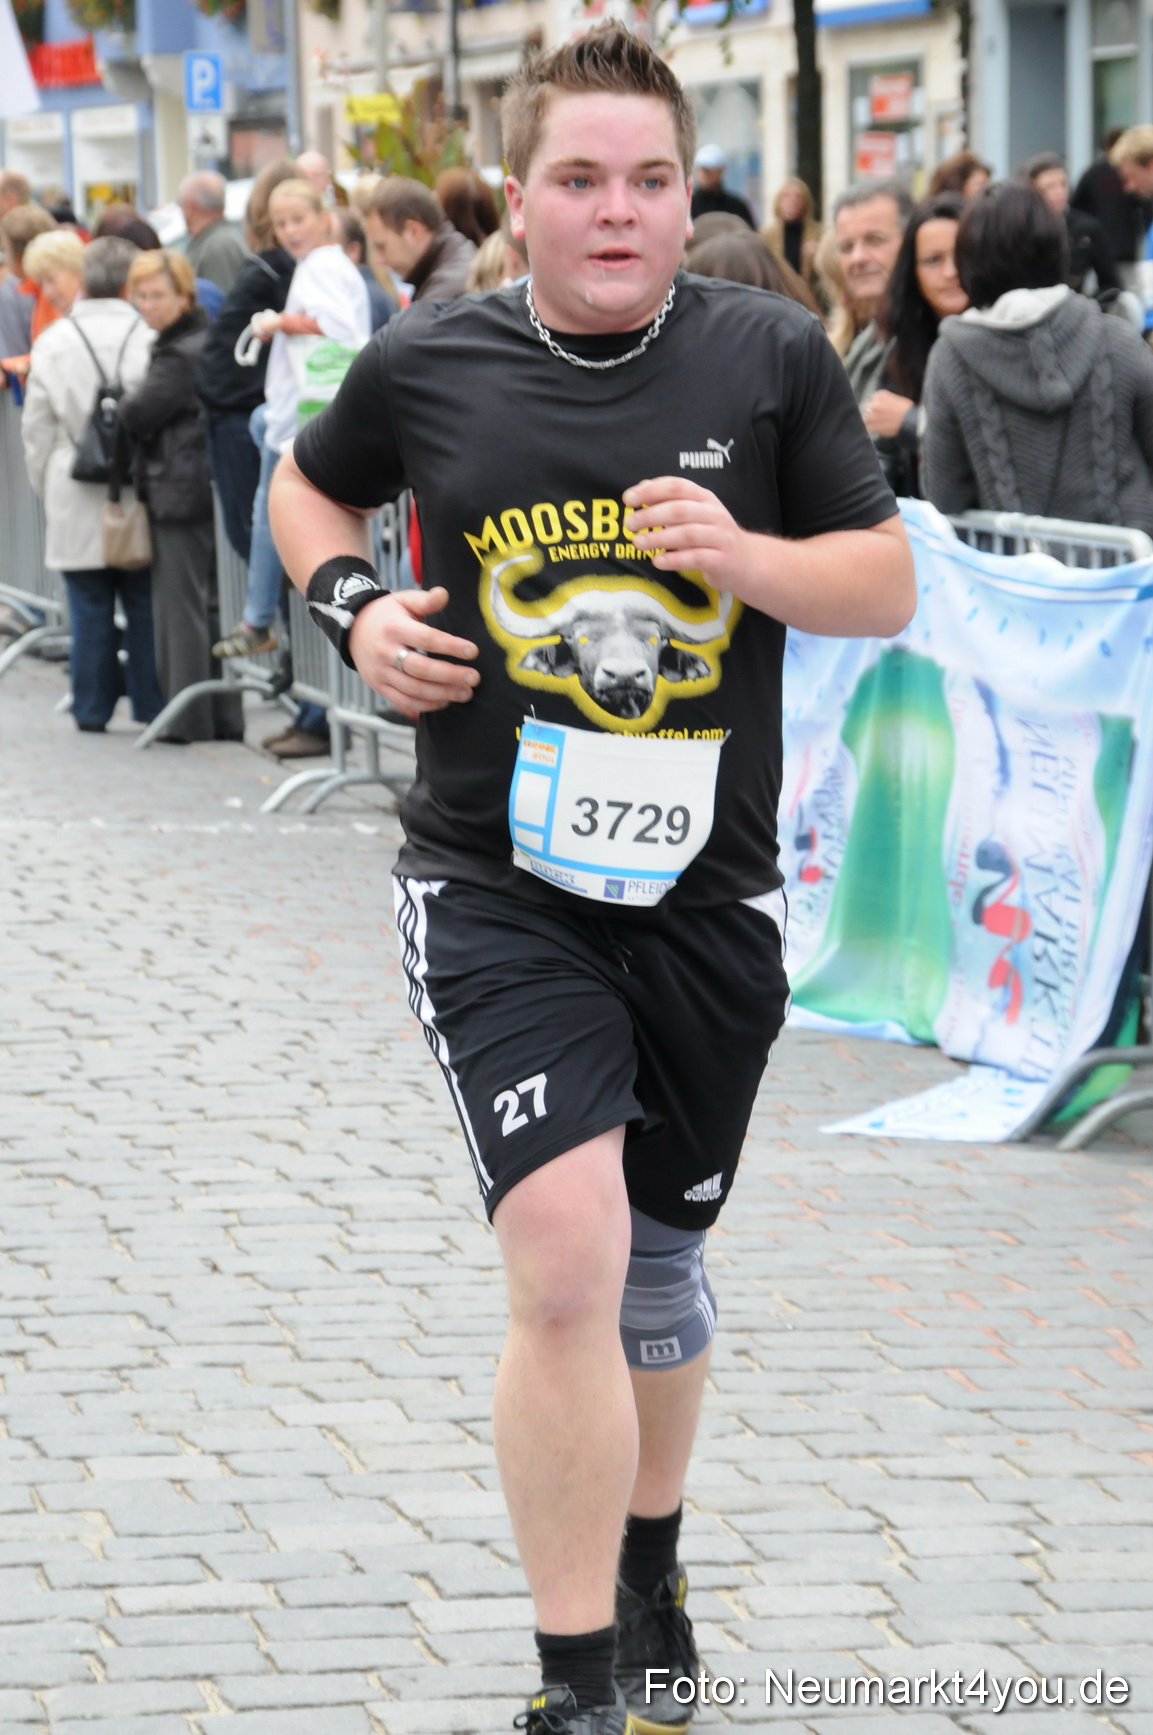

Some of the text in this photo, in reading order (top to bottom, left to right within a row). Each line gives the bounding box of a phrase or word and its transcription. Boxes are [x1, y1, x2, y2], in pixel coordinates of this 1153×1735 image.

[191, 58, 216, 104] P
[679, 451, 723, 468] PUMA
[548, 542, 610, 563] ENERGY
[571, 797, 691, 846] 3729
[628, 880, 674, 894] PFLEID
[493, 1072, 548, 1137] 27
[684, 1188, 722, 1202] adidas
